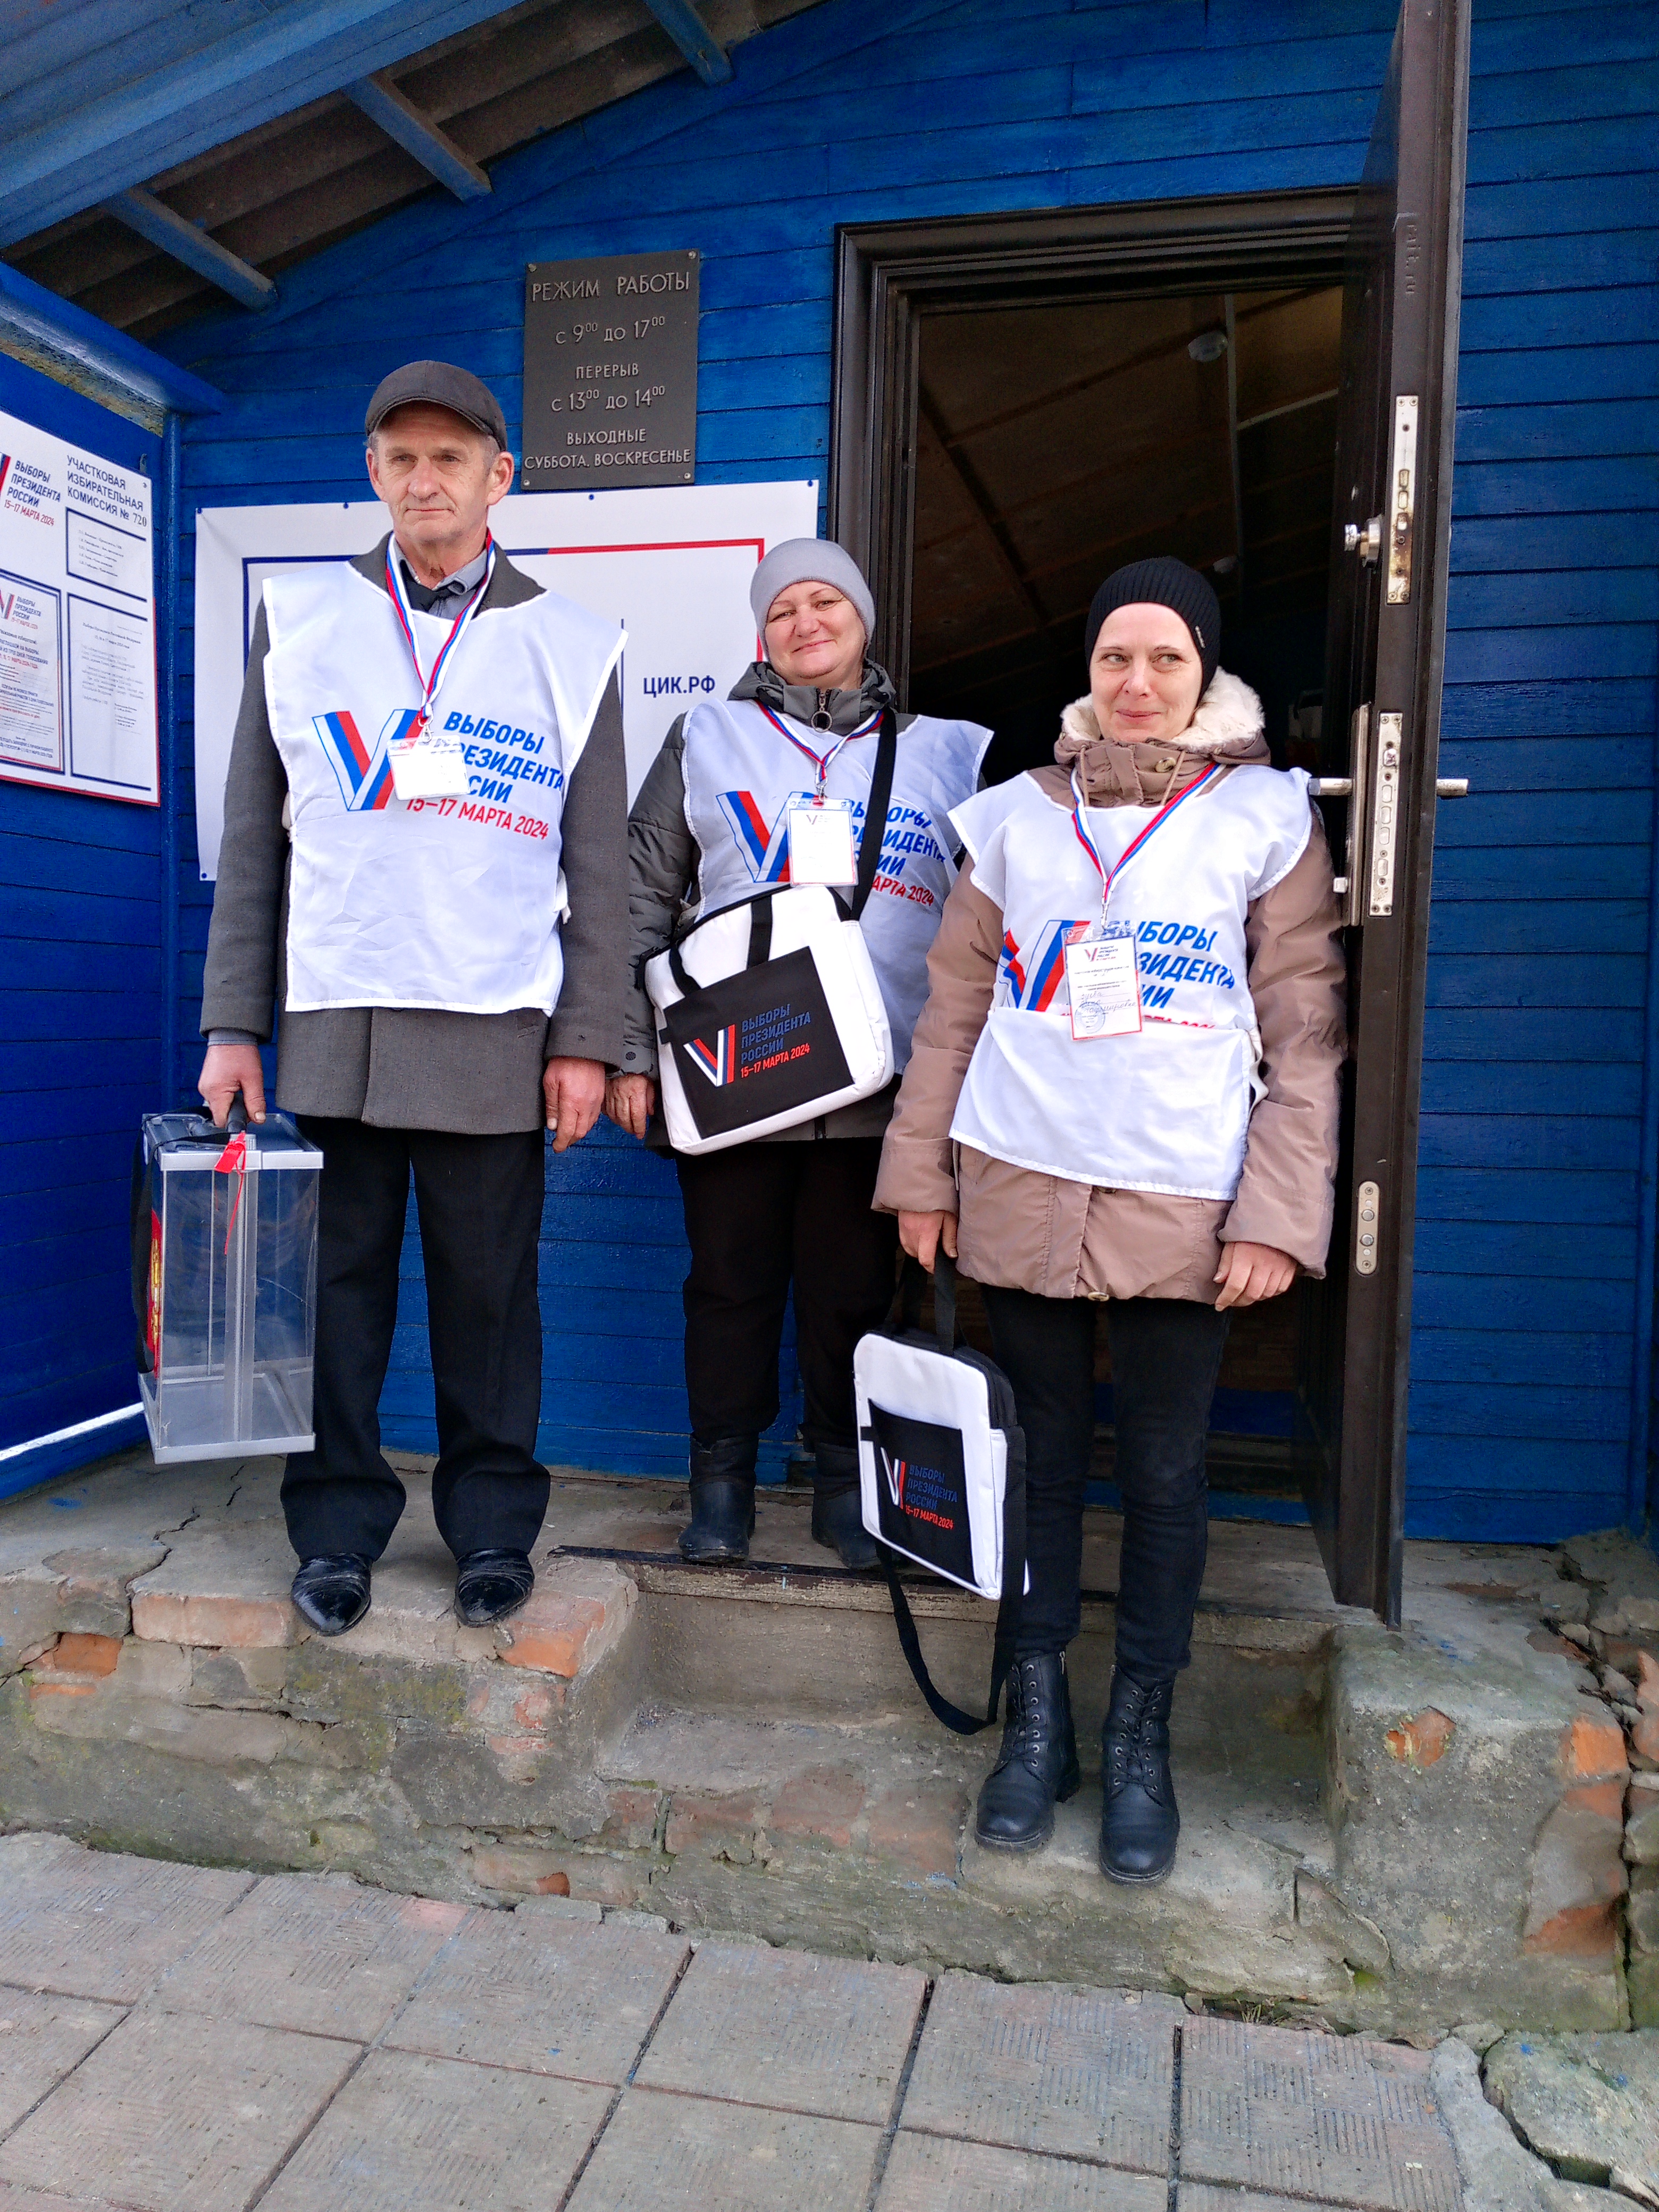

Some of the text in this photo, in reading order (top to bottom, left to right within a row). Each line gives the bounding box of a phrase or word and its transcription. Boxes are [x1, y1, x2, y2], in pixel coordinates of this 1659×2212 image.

[532, 272, 690, 302] РЕЖИМ РАБОТЫ
[576, 362, 640, 380] ПЕРЕРЫВ
[566, 428, 647, 446] ВЫХОДНЫЕ
[15, 460, 51, 483] ВЫБОРЫ
[593, 449, 691, 467] ВОСКРЕСЕНЬЕ
[67, 455, 126, 490] УЧАСТКОВАЯ
[7, 487, 40, 508] РОССИИ
[11, 473, 61, 502] ПРЕЗИДЕНТА
[67, 471, 144, 512] ИЗБИРАТЕЛЬНАЯ
[20, 506, 40, 521] МАРТА
[40, 514, 55, 526] 2024
[68, 486, 147, 527] КОМИССИЯ № 720
[643, 675, 715, 698] ЦИК.РФ
[443, 711, 544, 755] ВЫБОРЫ
[460, 742, 564, 790] ЕЗИДЕНТА
[458, 801, 513, 831] МАРТА
[514, 815, 549, 840] 2024
[872, 875, 934, 907] АРТА 2024
[1137, 952, 1235, 990] ЗИДЕНТА
[741, 1011, 811, 1049] ПРЕЗИДЕНТА
[742, 1004, 791, 1033] ВЫБОРЫ
[741, 1037, 784, 1064] РОССИИ
[763, 1051, 790, 1070] МАРТА
[790, 1043, 811, 1060] 2024
[909, 1464, 945, 1483] ВЫБОРЫ
[906, 1492, 939, 1511] РОССИИ
[908, 1478, 958, 1503] ПРЕЗИДЕНТА
[920, 1509, 939, 1526] МАРТА
[938, 1516, 954, 1530] 2024
